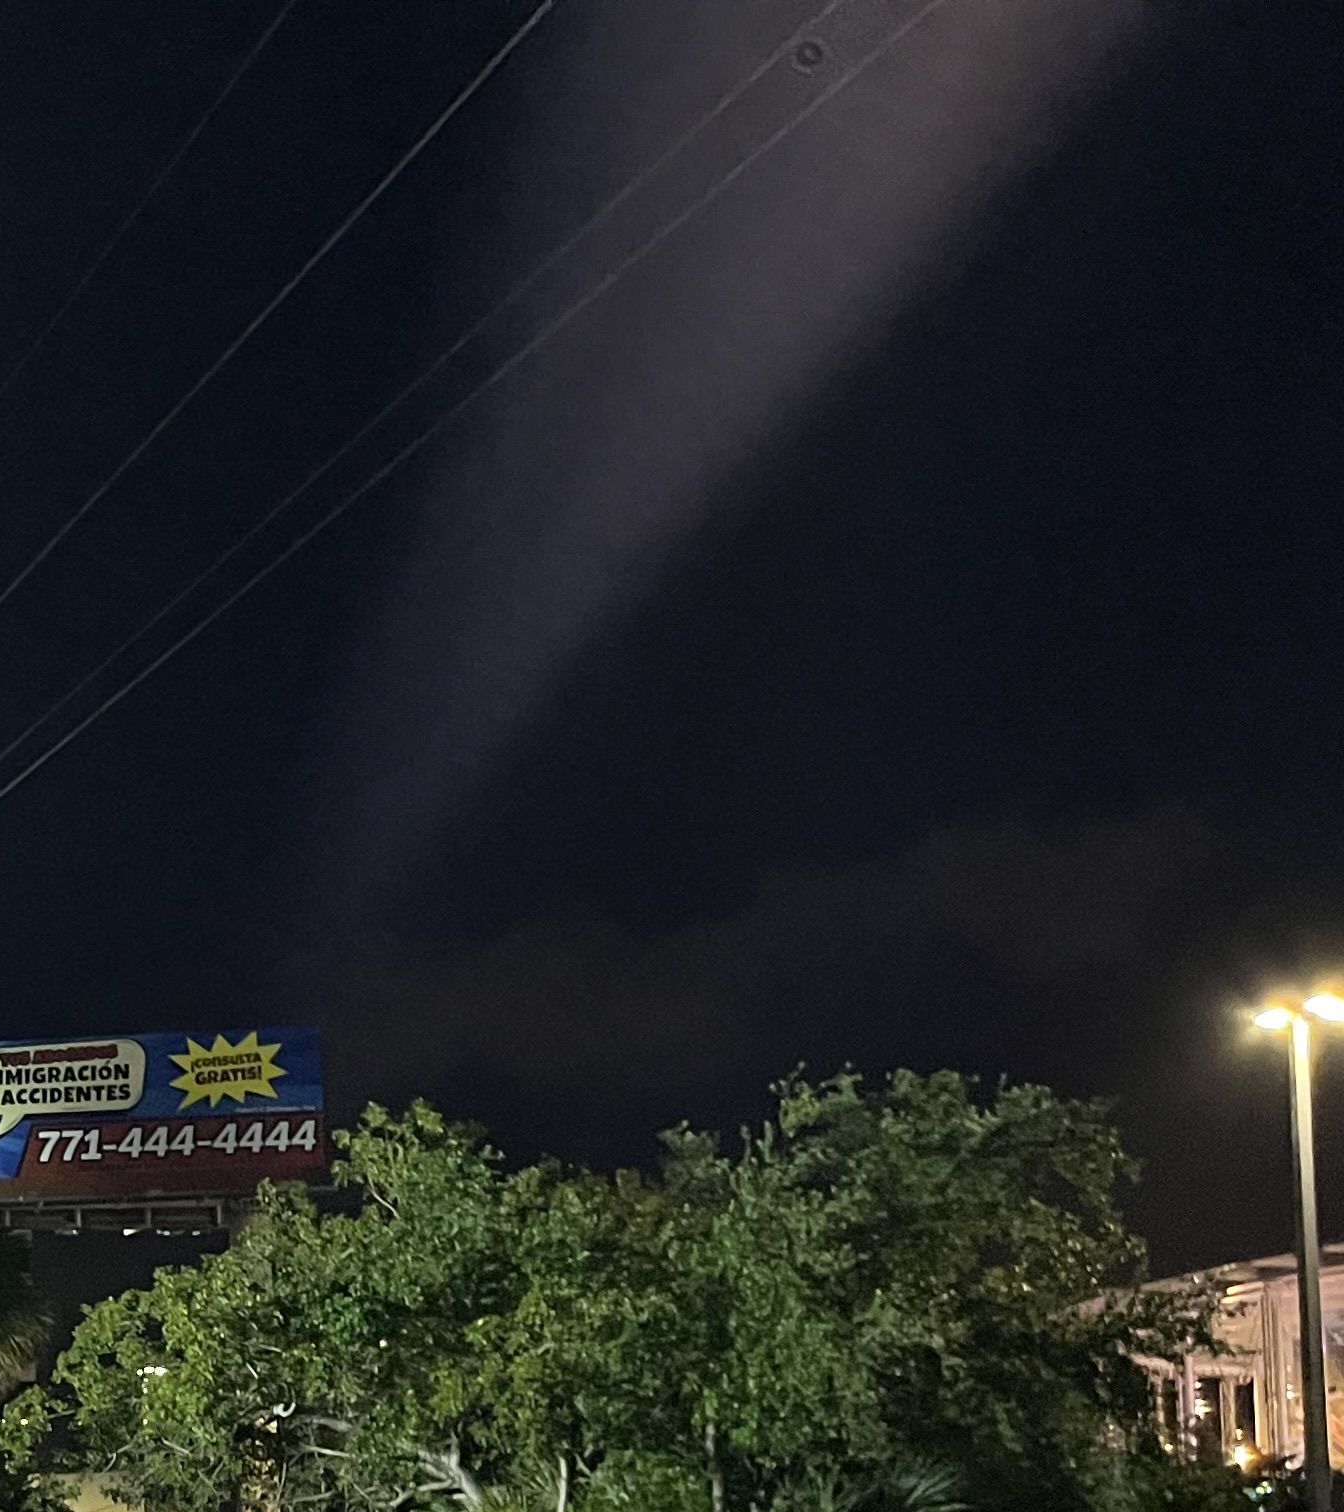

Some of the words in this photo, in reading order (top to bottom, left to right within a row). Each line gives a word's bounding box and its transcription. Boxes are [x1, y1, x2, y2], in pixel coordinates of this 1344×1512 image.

[194, 1065, 263, 1086] GRATIS!
[0, 1083, 132, 1106] ACCIDENTES
[38, 1119, 316, 1163] 771-444-4444
